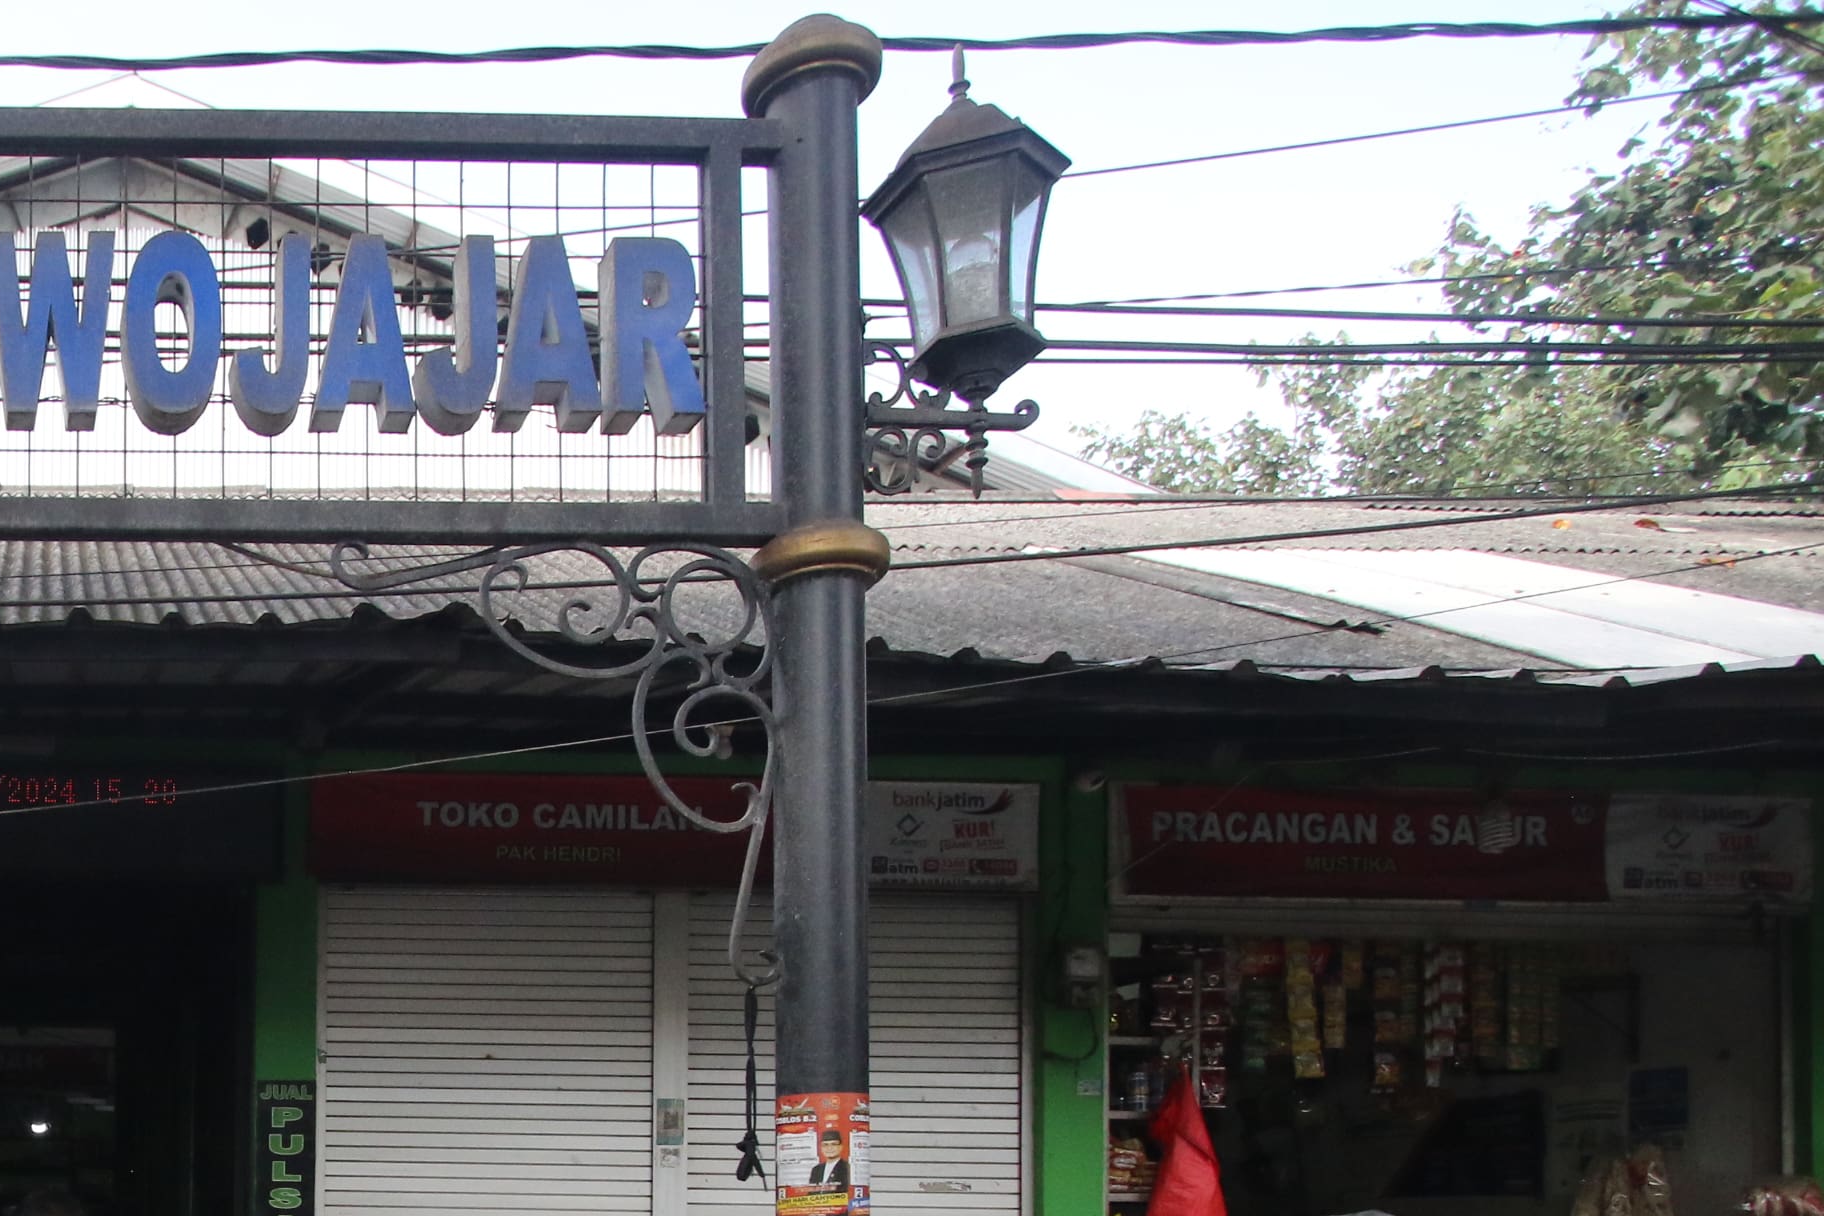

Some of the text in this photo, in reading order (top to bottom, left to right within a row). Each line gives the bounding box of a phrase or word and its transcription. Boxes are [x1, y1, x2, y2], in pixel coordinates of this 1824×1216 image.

[93, 778, 121, 804] 15
[893, 791, 985, 812] bankjatim
[416, 800, 707, 832] TOKO CAMILAN
[1151, 811, 1549, 848] PRACANGAN & SAUR
[496, 845, 622, 864] PAK HENDRI
[1304, 856, 1398, 873] MUSTIKA
[260, 1083, 313, 1100] JUAL
